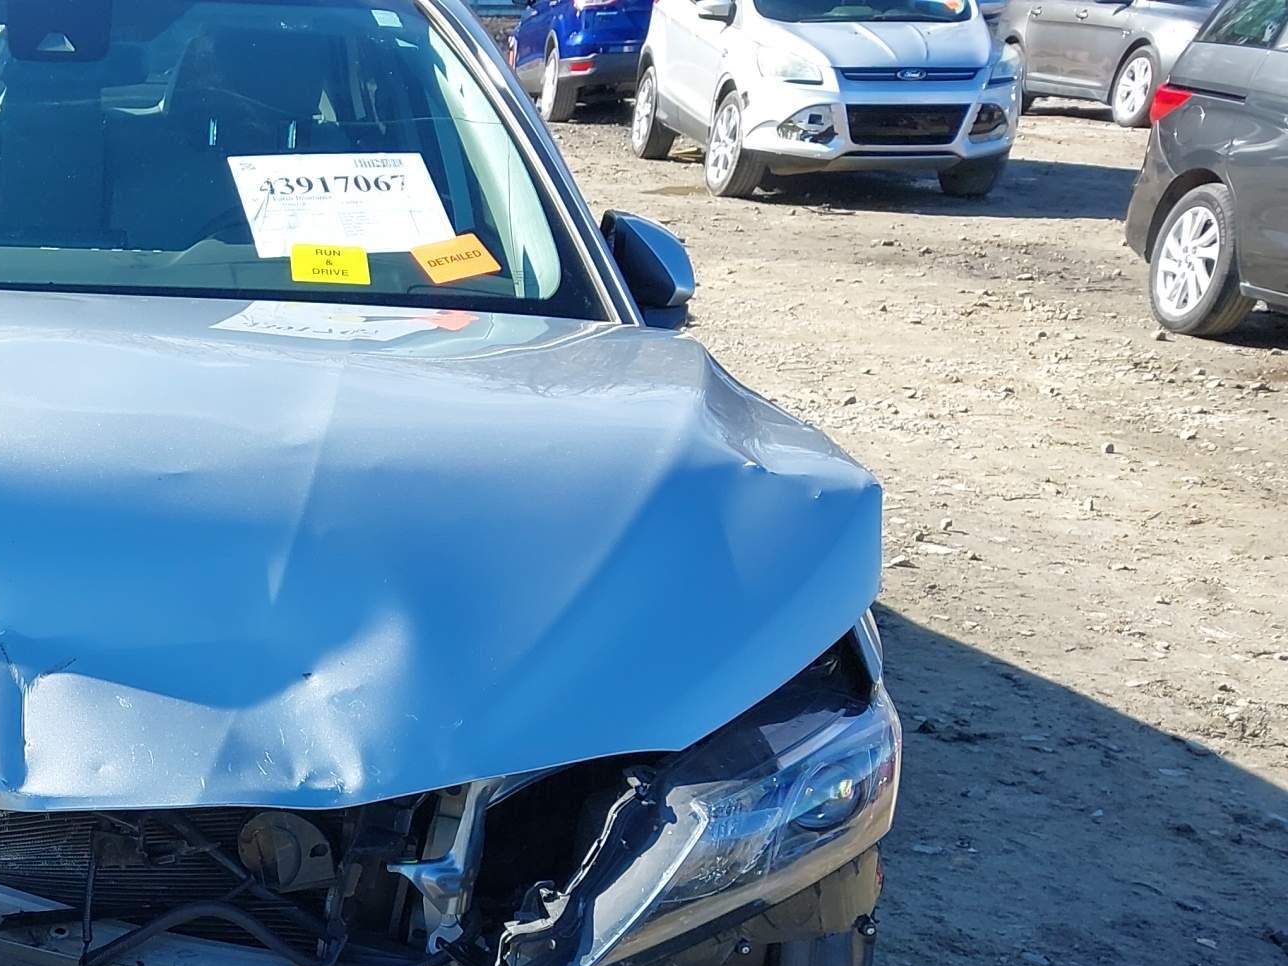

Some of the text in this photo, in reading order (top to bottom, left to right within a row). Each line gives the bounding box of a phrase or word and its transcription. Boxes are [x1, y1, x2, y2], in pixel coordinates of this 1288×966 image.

[259, 174, 405, 195] 43917067
[315, 248, 341, 257] RUN
[426, 249, 483, 269] DETAILED
[312, 267, 350, 277] DRIVE
